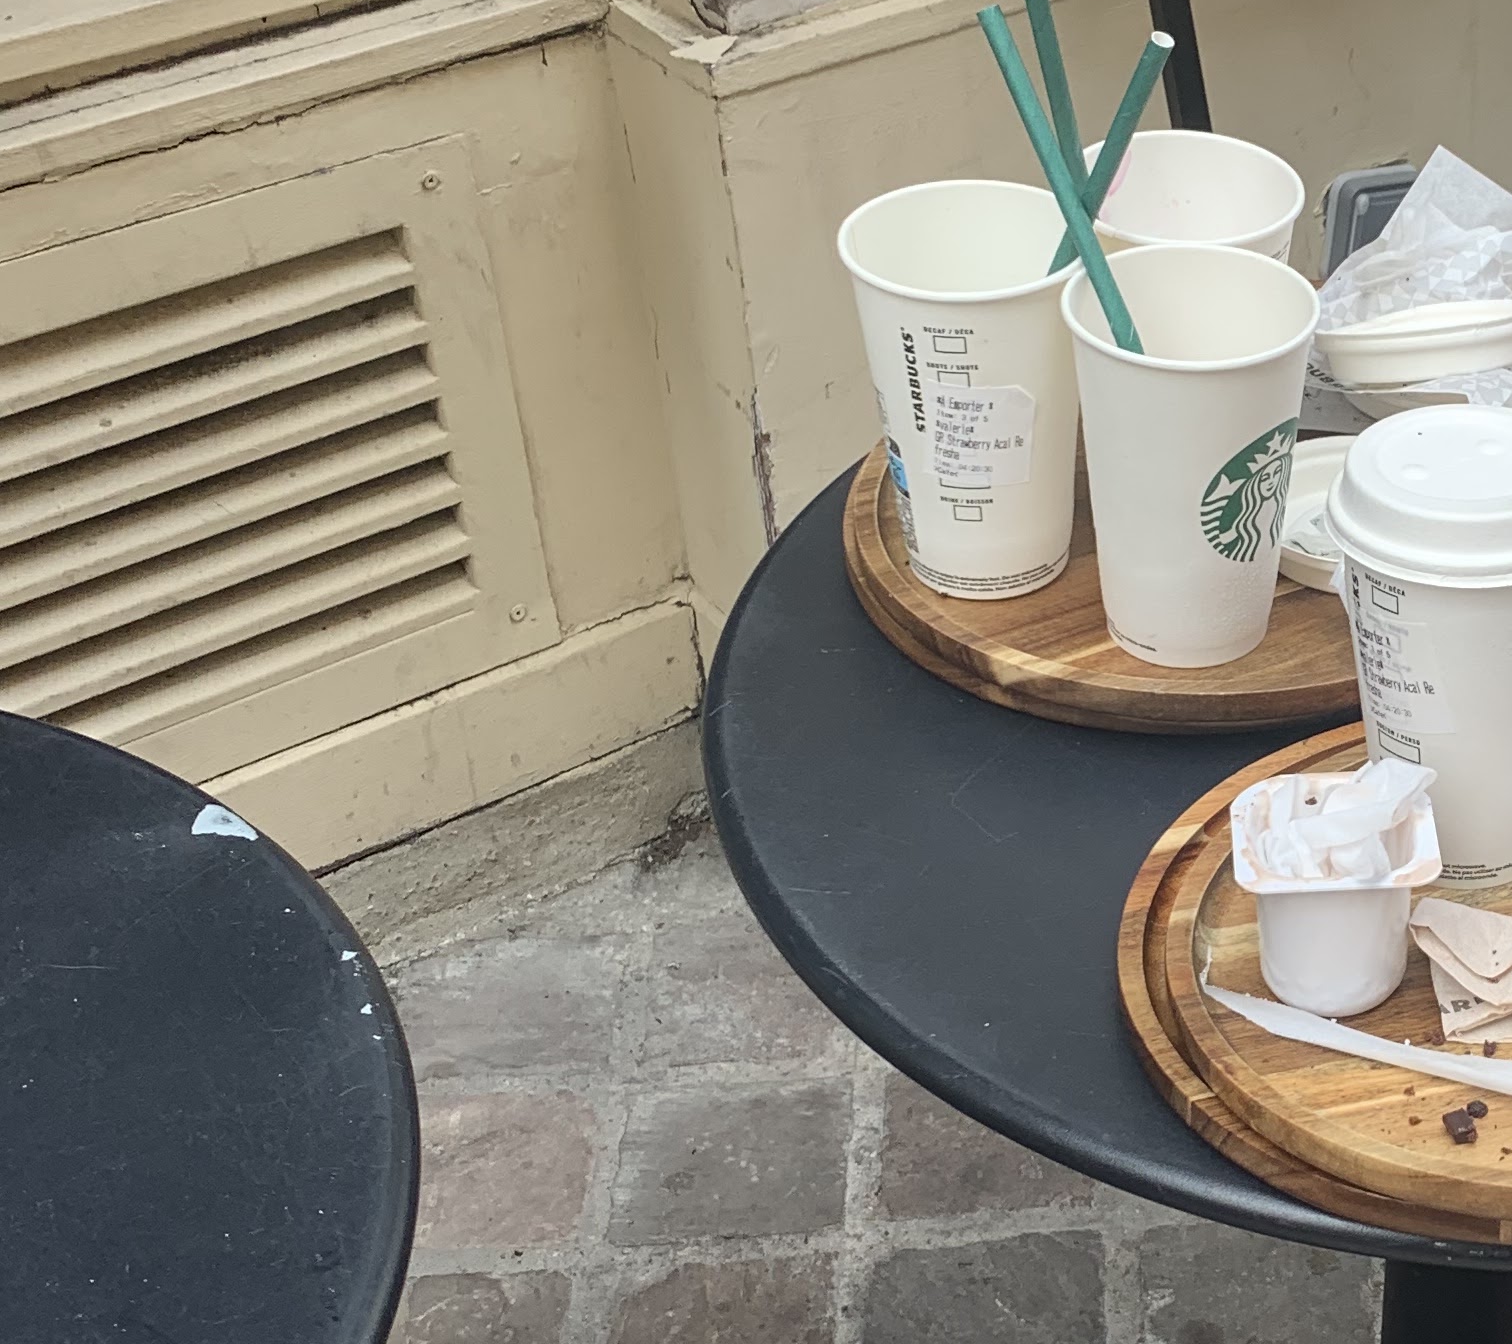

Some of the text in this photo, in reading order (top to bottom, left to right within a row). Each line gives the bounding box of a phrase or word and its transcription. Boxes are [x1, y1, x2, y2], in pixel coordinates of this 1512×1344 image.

[901, 328, 926, 433] STARBUCKS
[949, 397, 984, 413] Emporter
[947, 434, 991, 451] Strawberry
[1014, 435, 1024, 448] Re
[1423, 680, 1436, 695] Re
